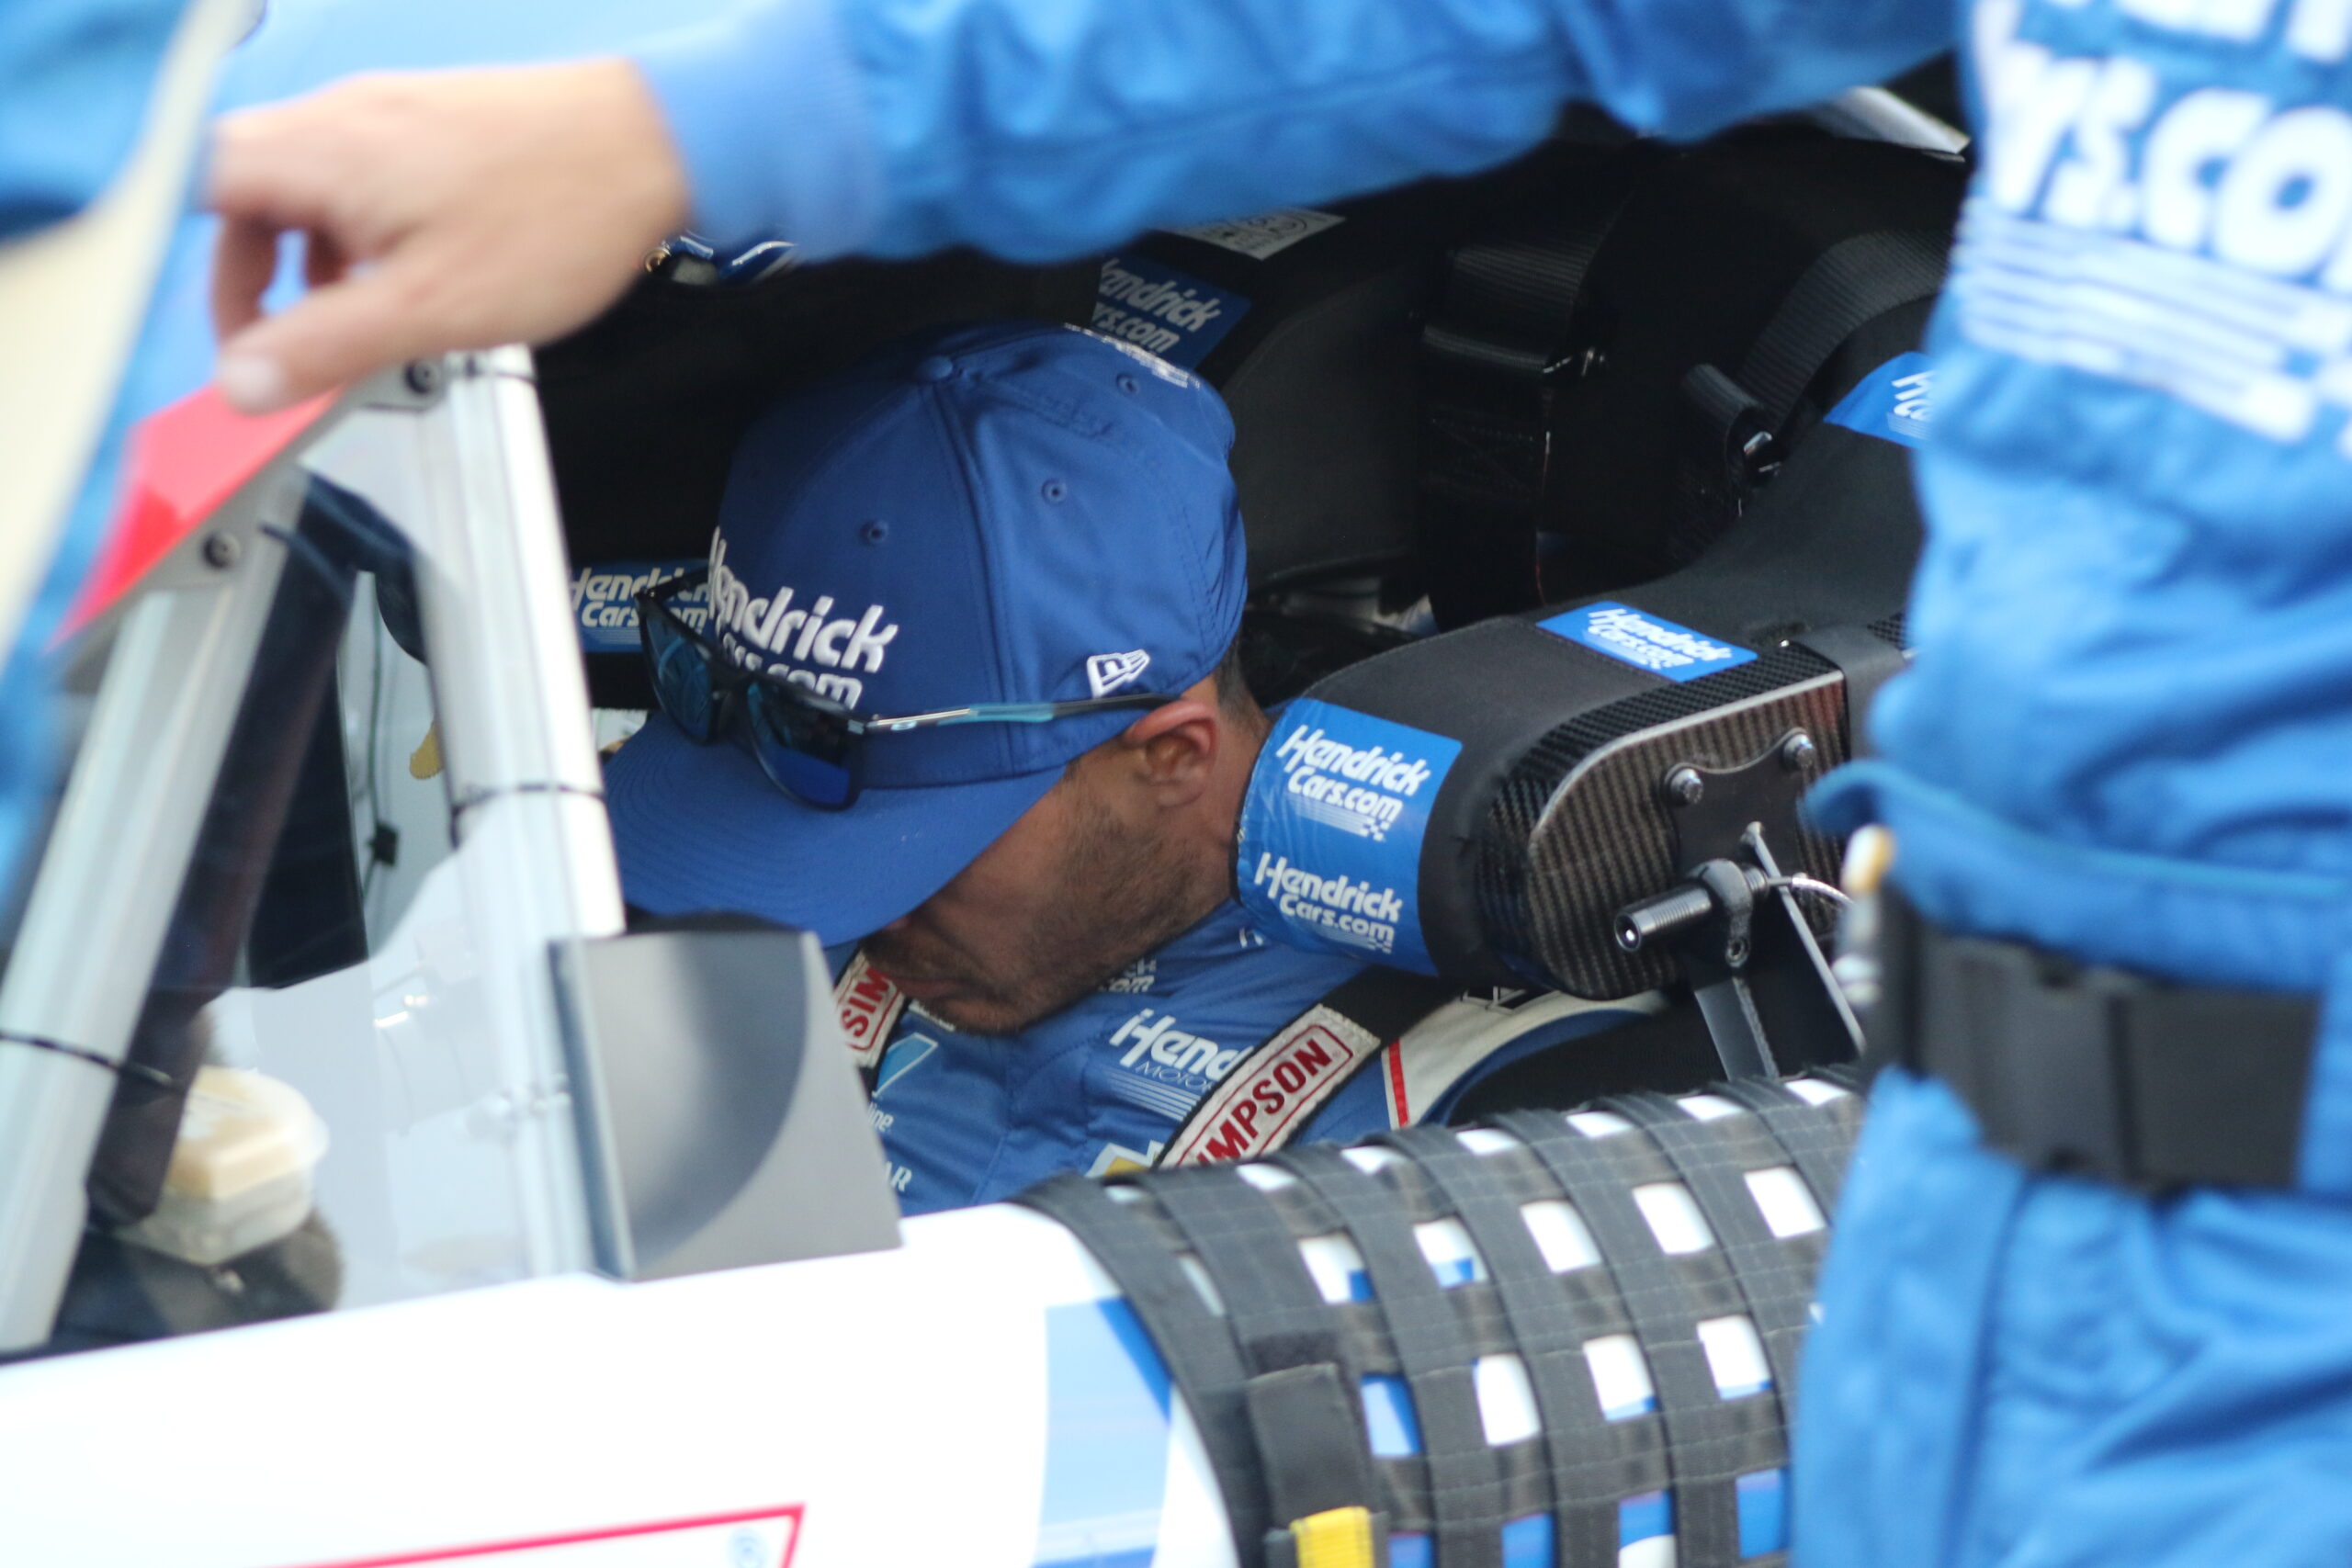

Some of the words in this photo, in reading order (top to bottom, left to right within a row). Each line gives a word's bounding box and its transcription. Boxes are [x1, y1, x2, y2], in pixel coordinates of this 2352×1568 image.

[1588, 608, 1733, 661] Hendrick
[1276, 725, 1430, 796] Hendrick
[1287, 765, 1403, 822] Cars.com
[1254, 852, 1402, 923] Hendrick
[1279, 893, 1395, 946] Cars.com
[841, 966, 892, 1038] SIM
[1109, 1008, 1255, 1081] Hend
